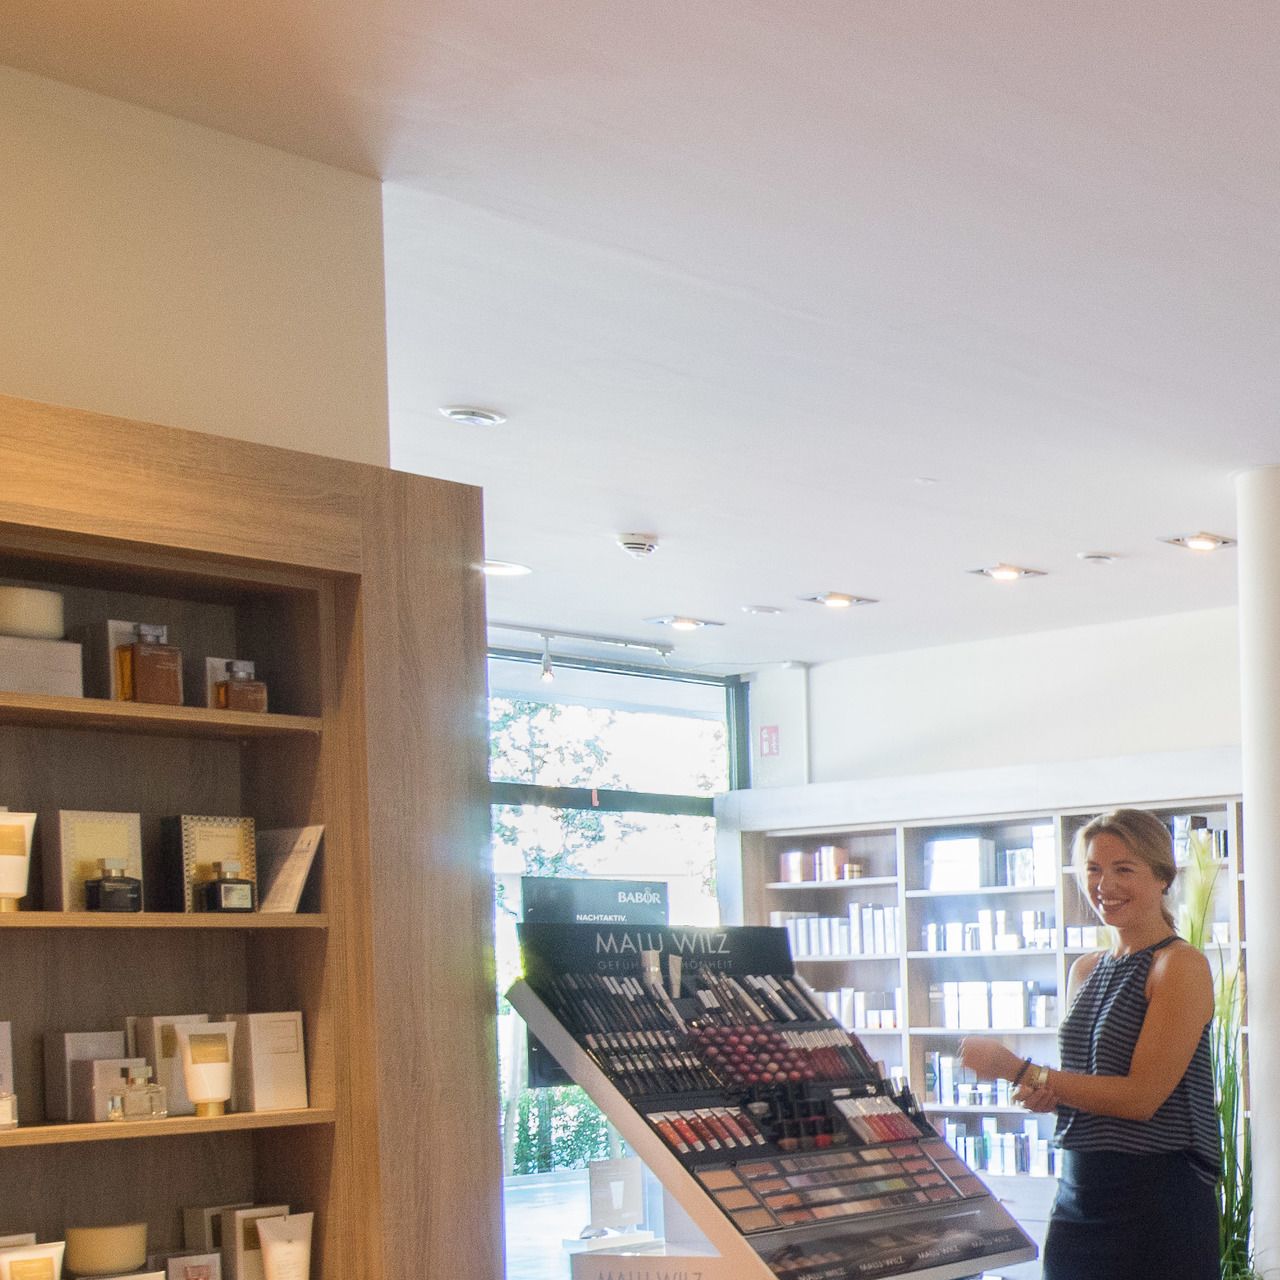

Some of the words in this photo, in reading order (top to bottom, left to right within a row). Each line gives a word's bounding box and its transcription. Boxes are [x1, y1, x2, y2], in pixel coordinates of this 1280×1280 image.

[618, 889, 661, 904] BABOR
[596, 933, 663, 954] MALU
[672, 933, 731, 954] WILZ
